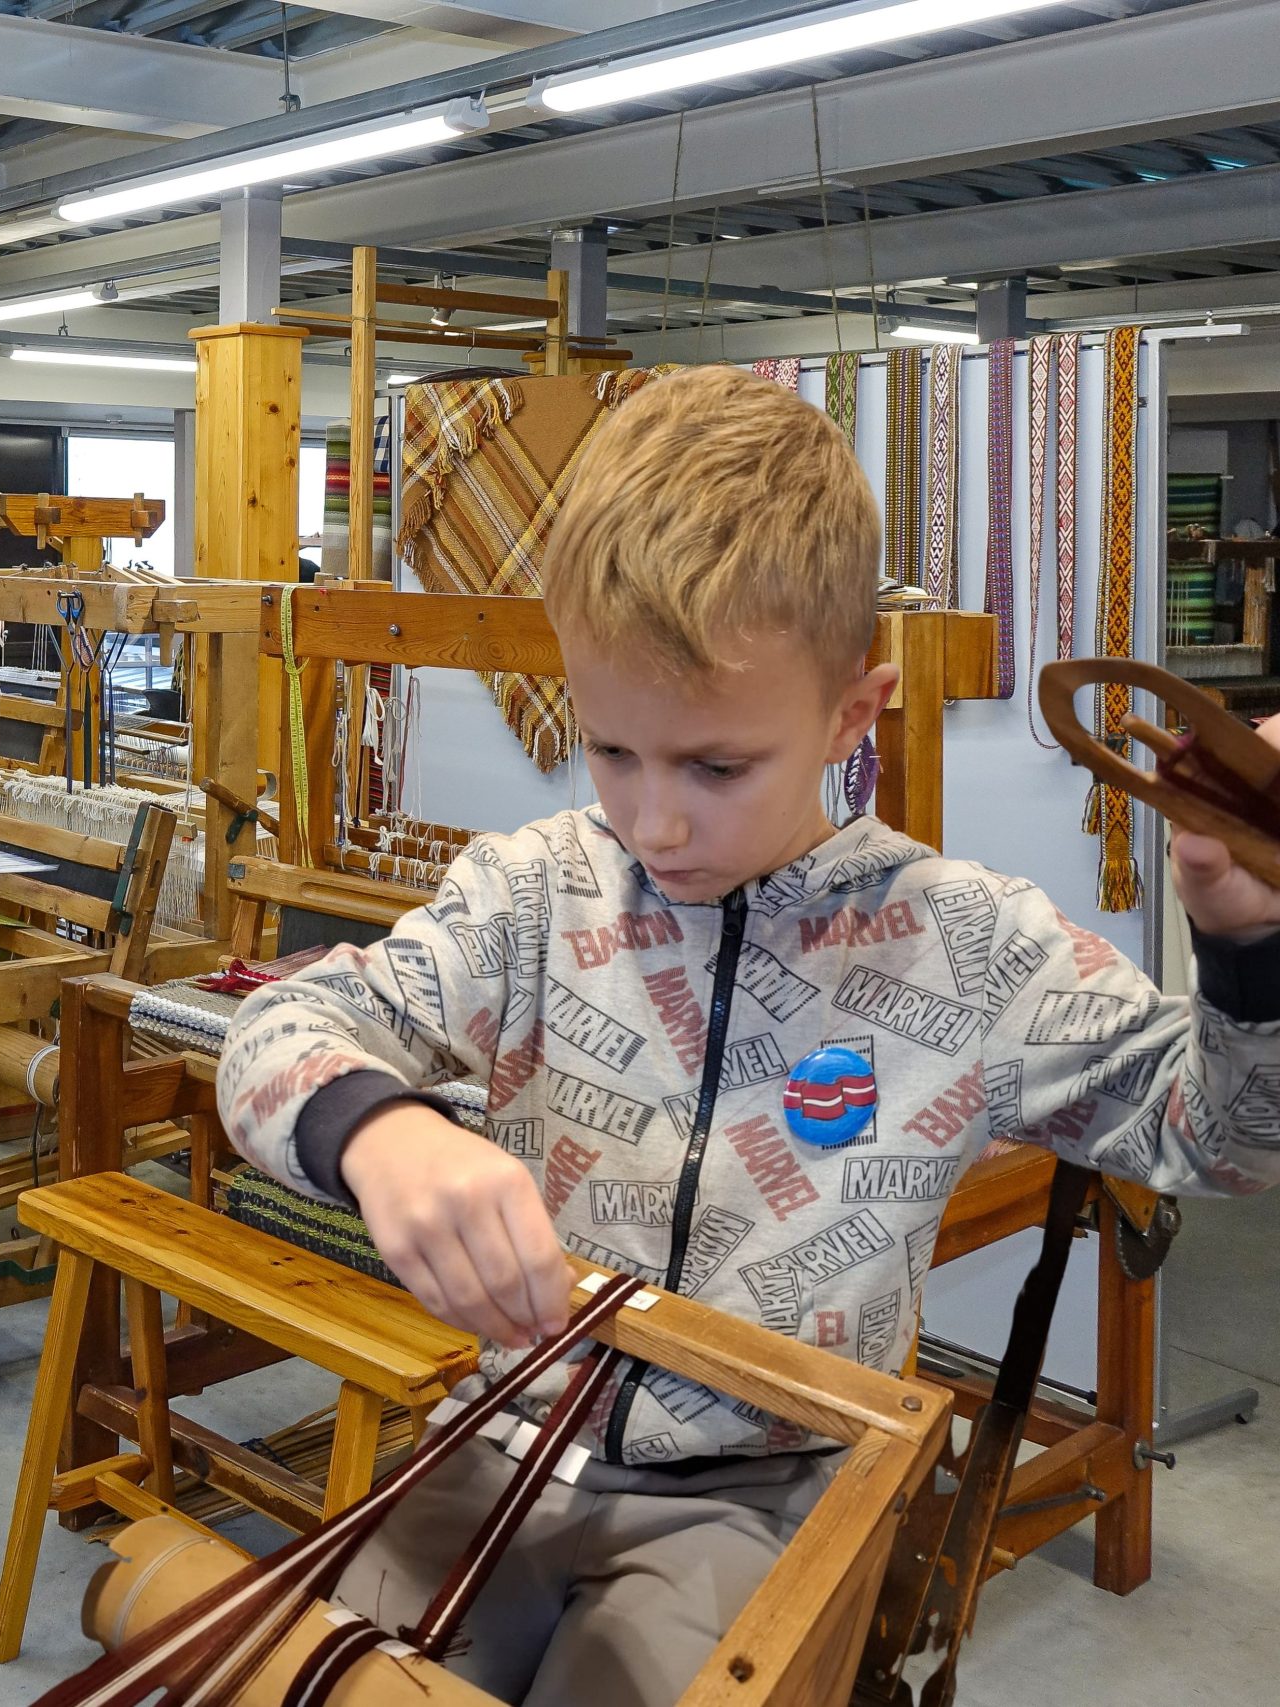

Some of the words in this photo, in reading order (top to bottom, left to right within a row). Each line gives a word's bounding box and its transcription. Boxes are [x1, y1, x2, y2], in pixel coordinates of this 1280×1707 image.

[560, 909, 684, 970] MARVEL
[798, 900, 926, 954] MARVEL
[932, 881, 993, 993] MARVEL
[642, 965, 709, 1077] MARVEL
[837, 970, 976, 1052] MARVEL
[985, 937, 1043, 1024] RVEL
[546, 980, 634, 1067] ARVEL
[488, 1119, 540, 1157] VEL
[547, 1067, 642, 1140] ARVEL
[901, 1060, 987, 1148] ARVEL
[545, 1134, 602, 1222] ARVEL
[594, 1184, 677, 1224] MARV
[724, 1113, 820, 1222] MARVEL
[846, 1159, 958, 1200] MARVE
[685, 1211, 748, 1294] MARV
[864, 1295, 897, 1370] ARVEL
